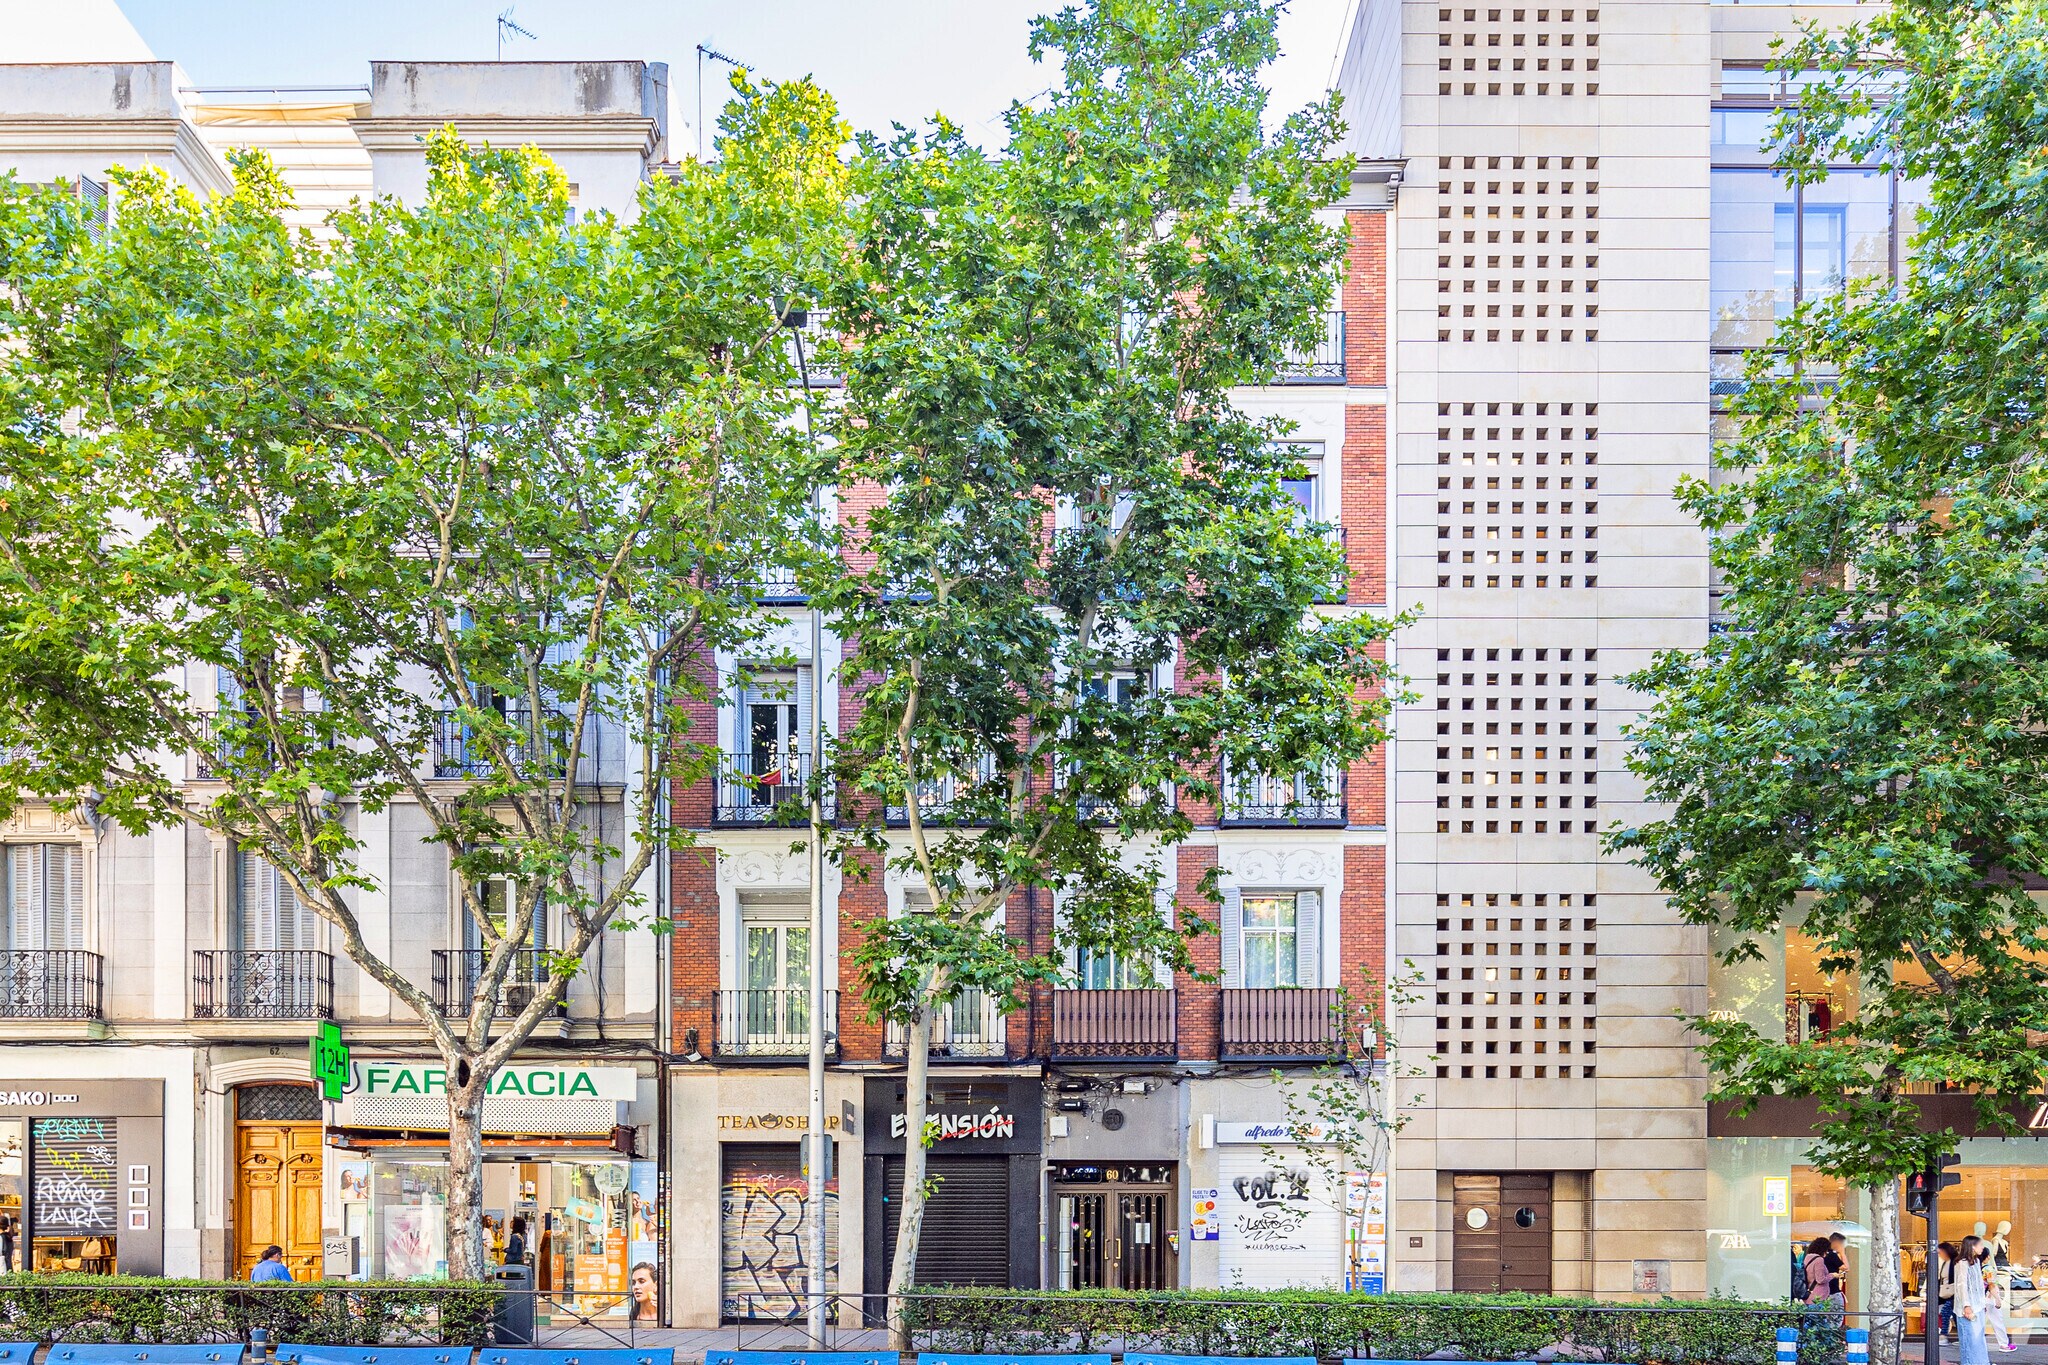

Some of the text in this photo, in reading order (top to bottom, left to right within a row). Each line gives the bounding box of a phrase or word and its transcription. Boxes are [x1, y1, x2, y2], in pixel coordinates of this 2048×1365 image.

[320, 1046, 346, 1078] 12H
[367, 1069, 599, 1097] FARACIA
[717, 1115, 841, 1130] TEA SHP
[1106, 1169, 1119, 1180] 60
[1720, 1233, 1752, 1249] ZARA
